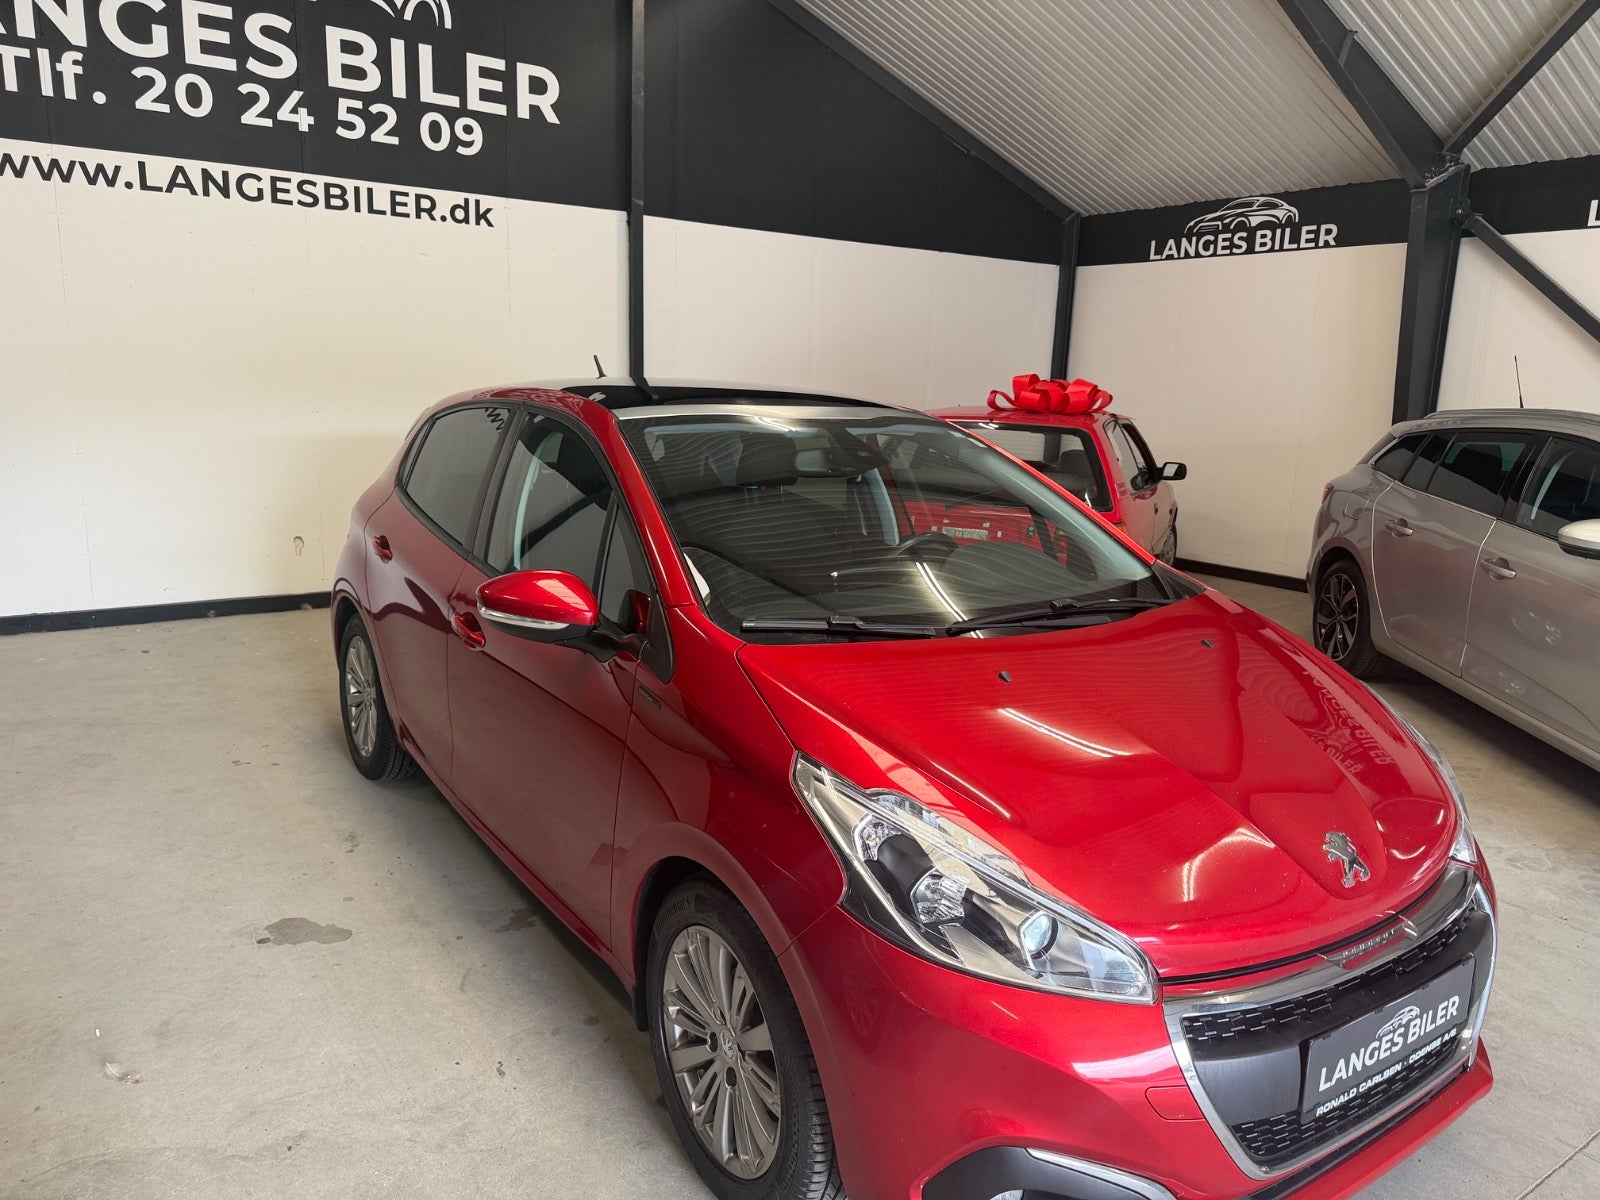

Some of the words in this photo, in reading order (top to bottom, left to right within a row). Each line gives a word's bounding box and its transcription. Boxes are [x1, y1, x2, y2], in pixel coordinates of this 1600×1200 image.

[0, 0, 297, 79] NGES
[325, 25, 561, 125] BILER
[0, 45, 107, 105] Tlf.
[130, 66, 213, 117] 20
[237, 83, 315, 132] 24
[336, 98, 400, 145] 52
[420, 112, 483, 156] 09
[0, 152, 495, 228] www.LANGESBILER.dk
[1150, 231, 1248, 260] LANGES
[1254, 223, 1338, 252] BILER
[1318, 1026, 1405, 1092] LANGES
[1407, 995, 1460, 1044] BILER
[1316, 1087, 1357, 1117] RONALD
[1359, 1061, 1402, 1093] CARLSEN
